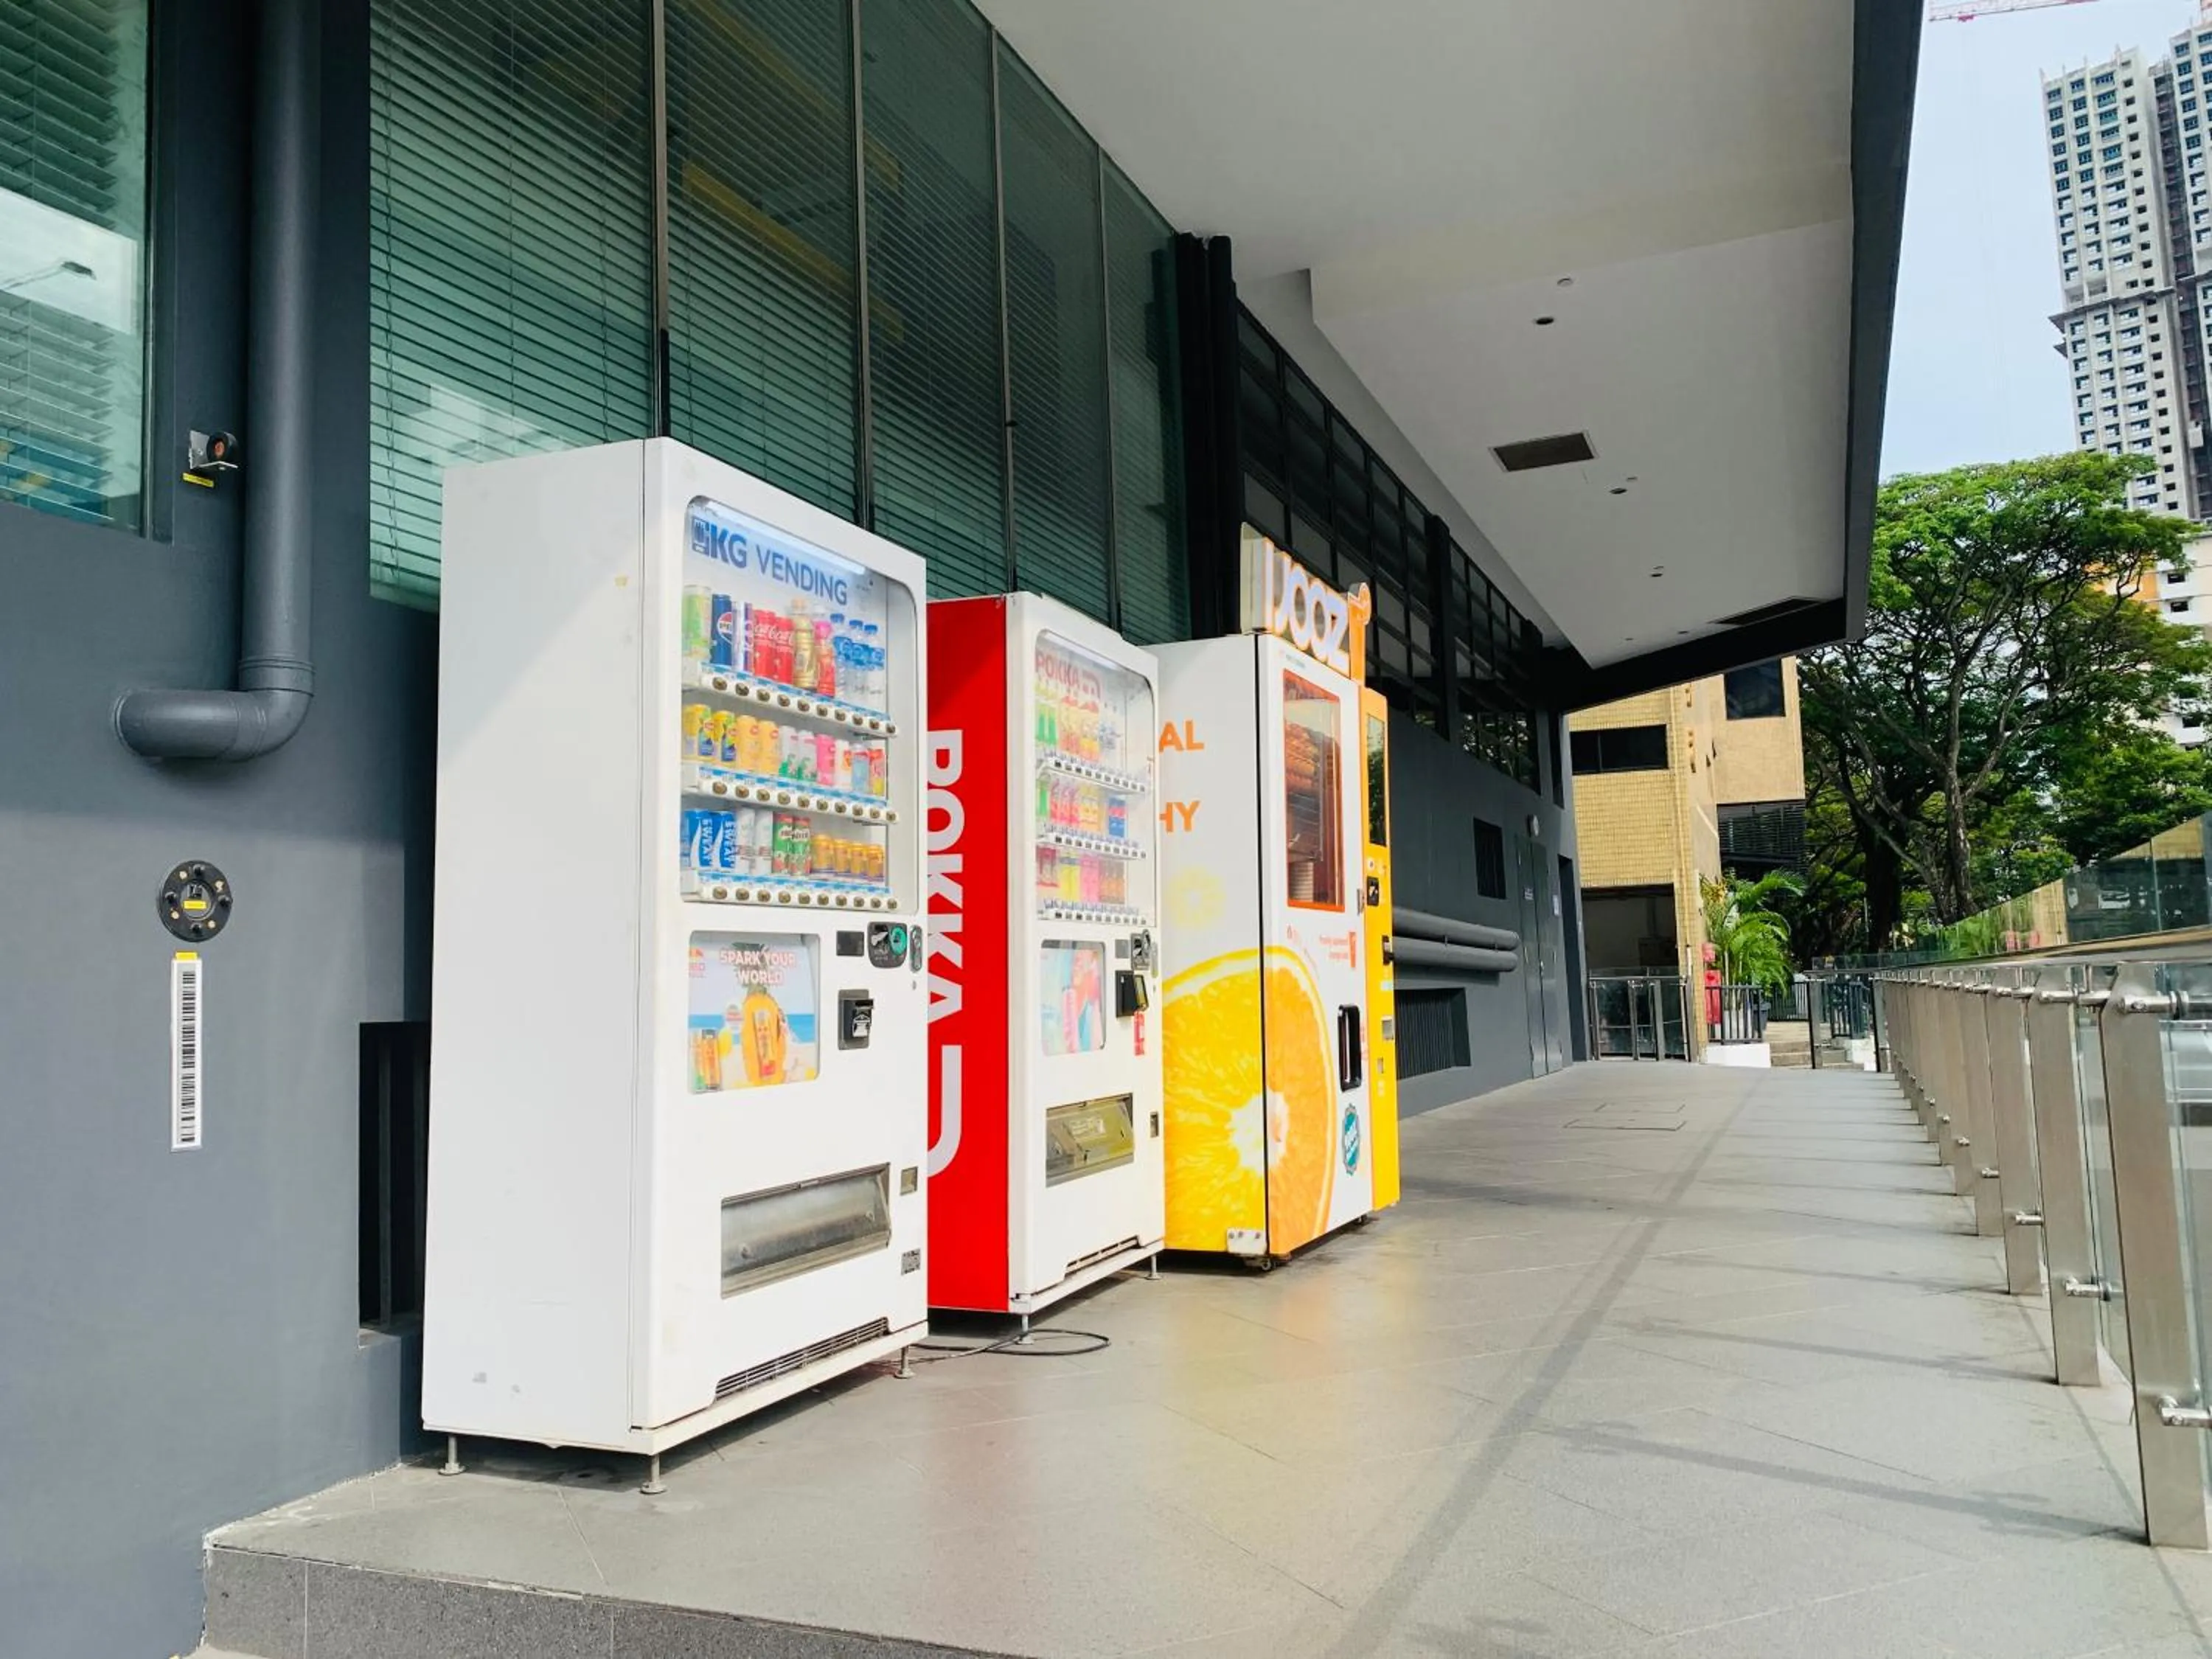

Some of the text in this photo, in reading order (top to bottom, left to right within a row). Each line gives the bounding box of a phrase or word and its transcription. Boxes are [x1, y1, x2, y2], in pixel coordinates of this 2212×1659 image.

[755, 544, 848, 606] VENDING
[720, 948, 796, 967] SPARK YOUR
[738, 969, 784, 985] WORLD
